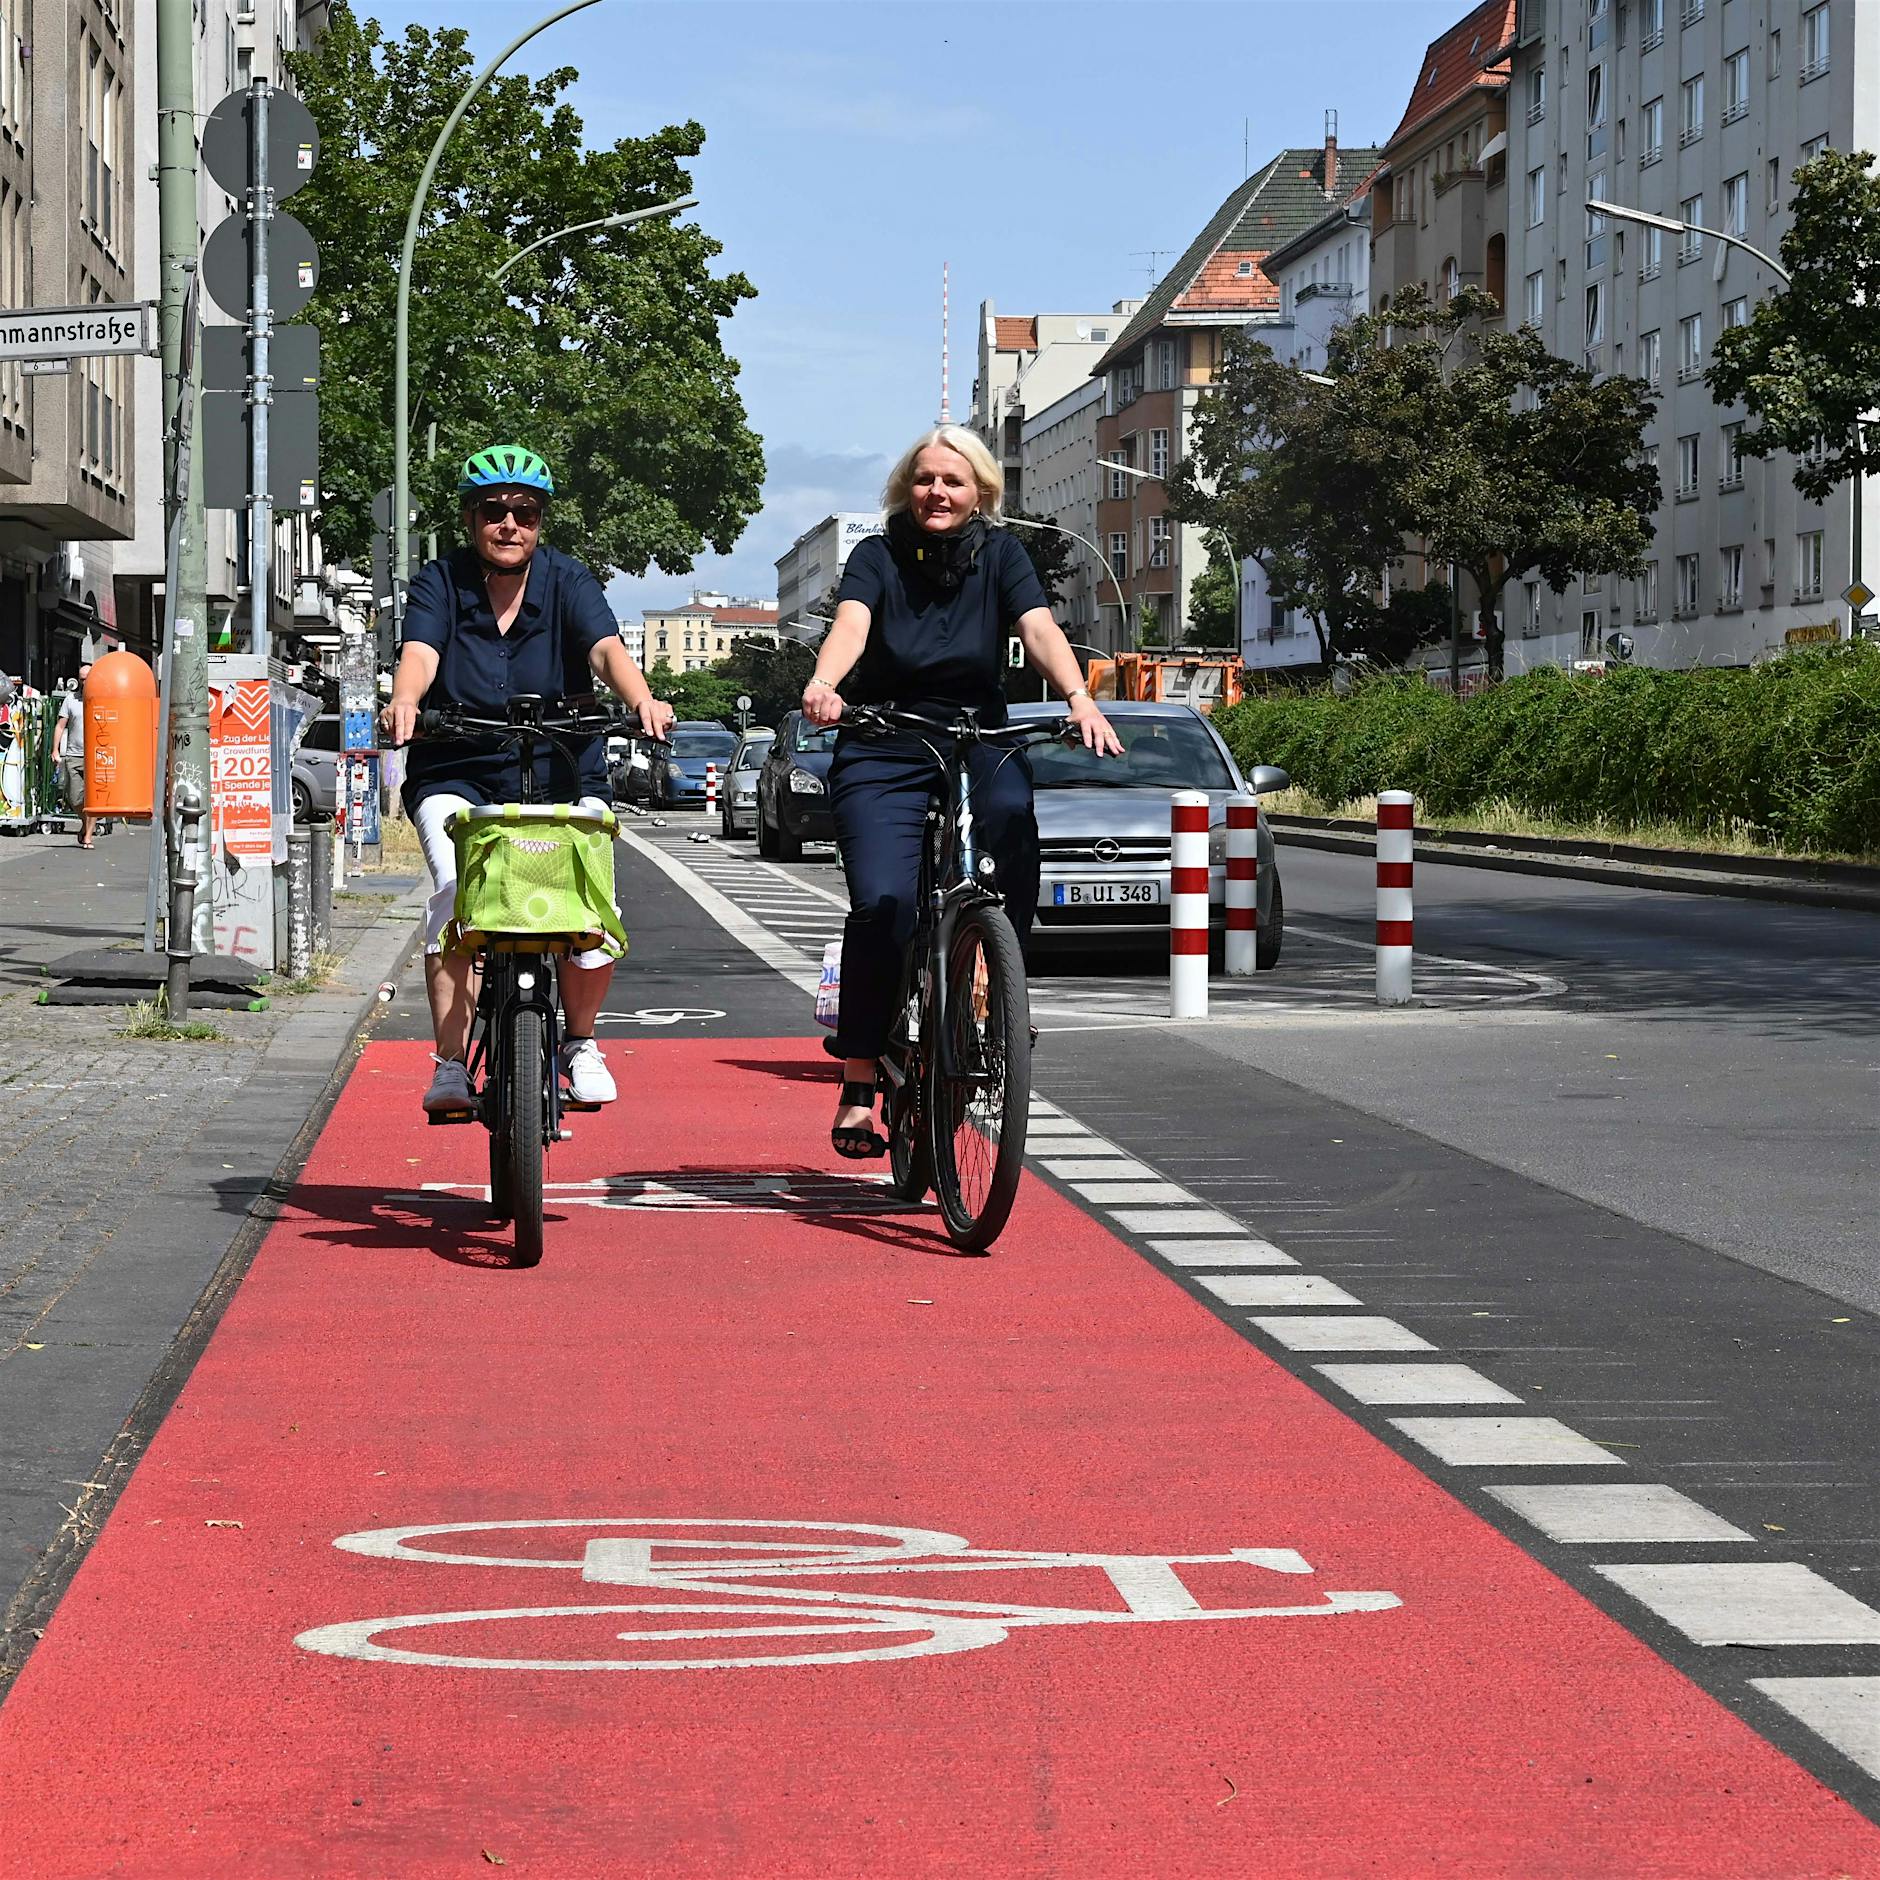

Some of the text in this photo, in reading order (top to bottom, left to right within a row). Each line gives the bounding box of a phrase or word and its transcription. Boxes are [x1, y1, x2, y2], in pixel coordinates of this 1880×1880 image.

[223, 735, 240, 744] Zug
[242, 734, 256, 742] der
[224, 756, 271, 777] 202
[224, 781, 260, 791] Spende
[1071, 887, 1081, 902] B
[1093, 886, 1114, 902] UI
[1120, 886, 1151, 902] 348
